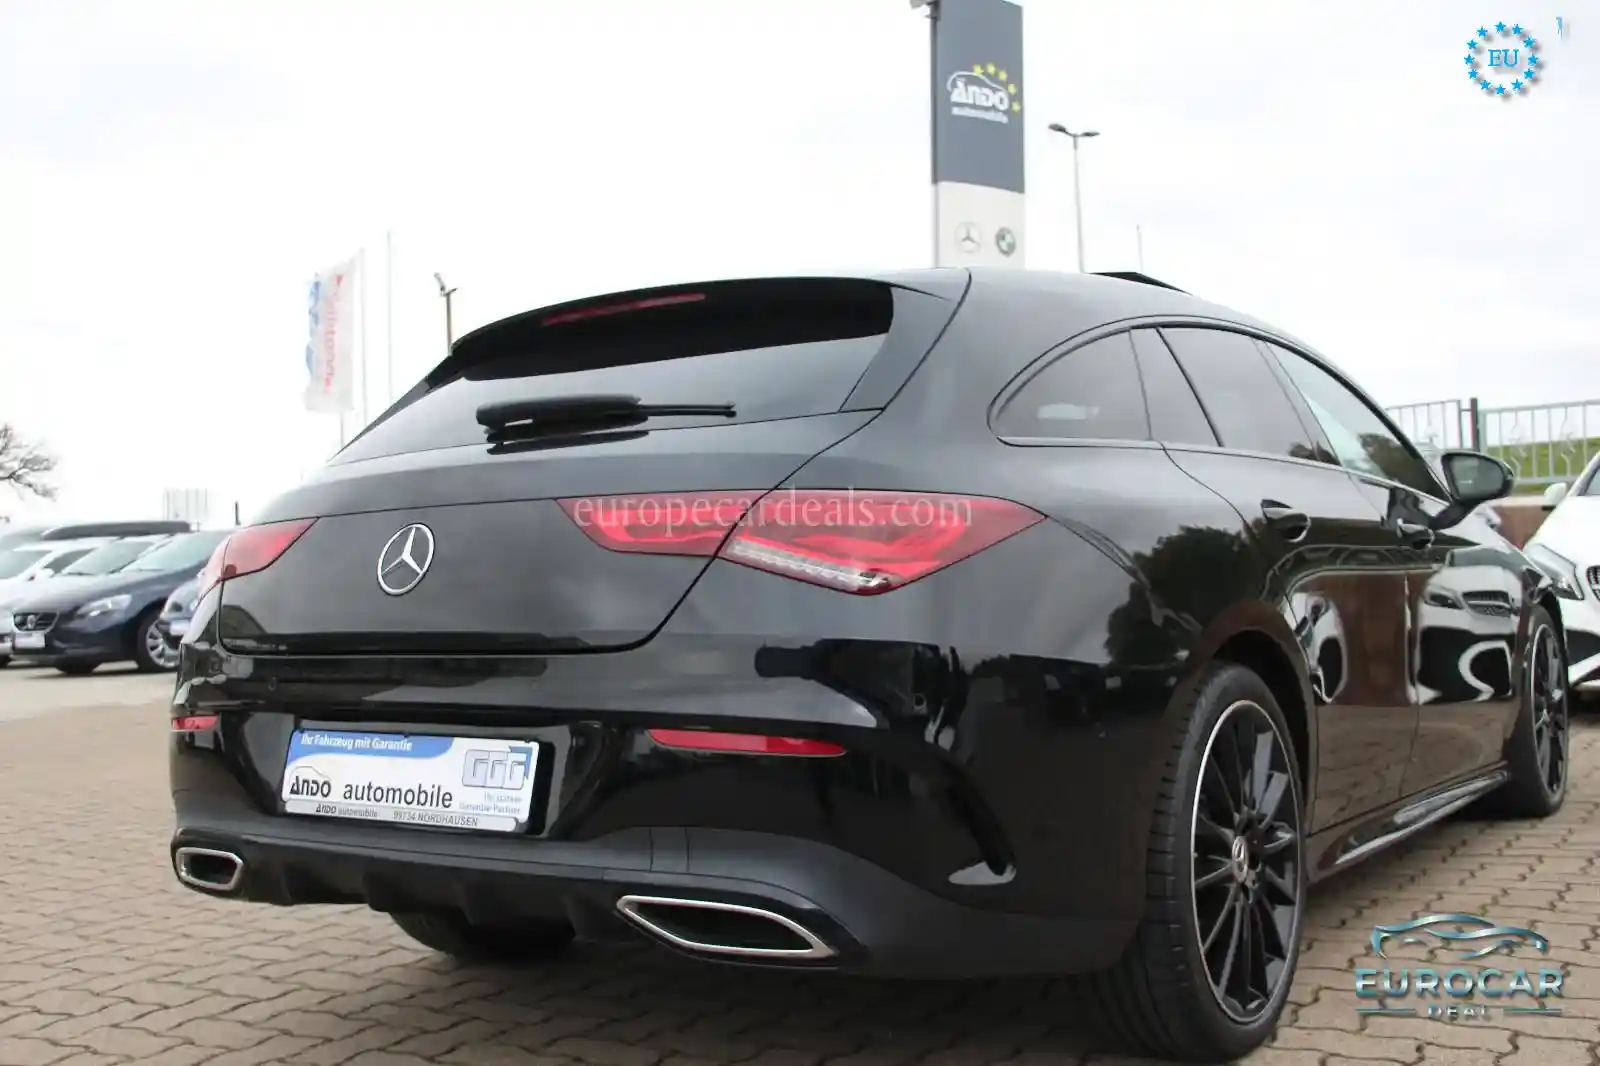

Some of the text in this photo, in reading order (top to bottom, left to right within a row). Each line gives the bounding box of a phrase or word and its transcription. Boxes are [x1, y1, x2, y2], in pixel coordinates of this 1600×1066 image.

[301, 733, 413, 751] Ihr Fahrzeug mit Garantie
[343, 781, 453, 809] automobile
[393, 810, 416, 821] 99734
[417, 811, 478, 827] NORDHAUSEN
